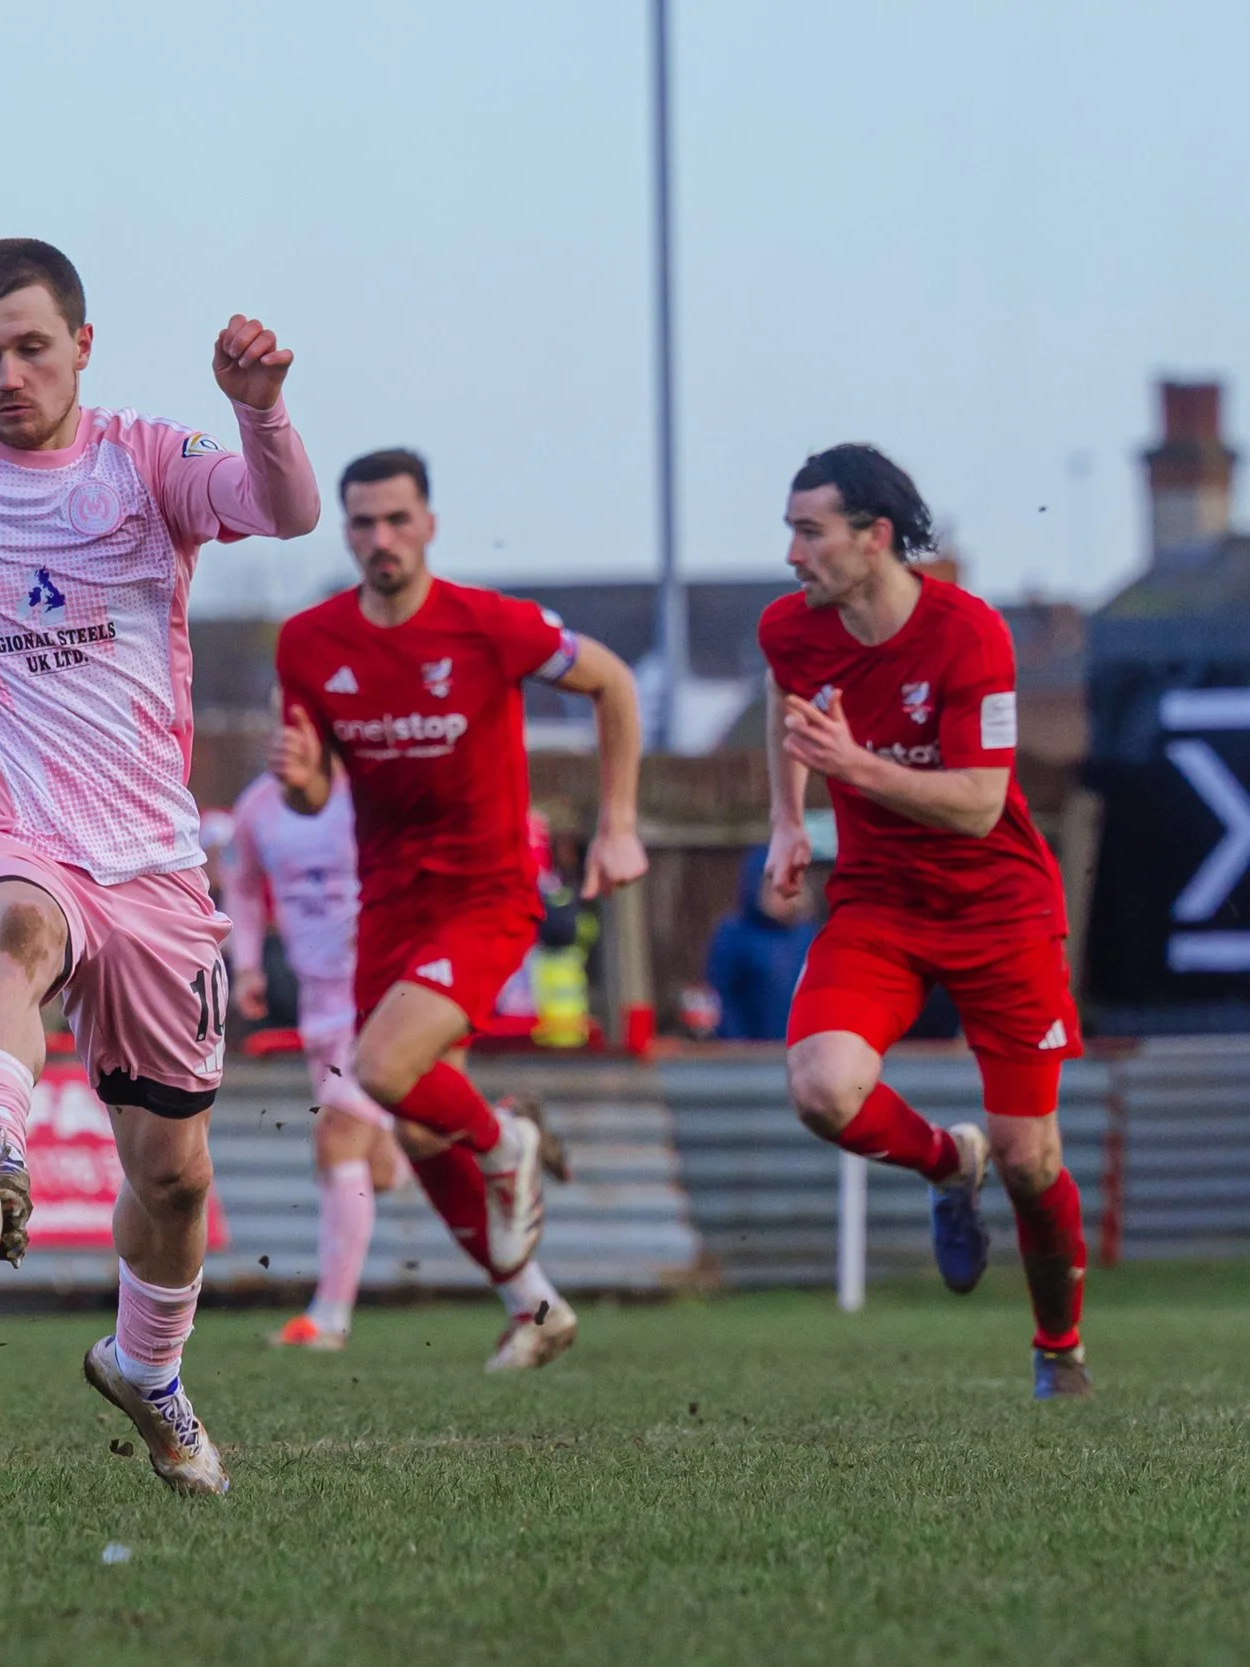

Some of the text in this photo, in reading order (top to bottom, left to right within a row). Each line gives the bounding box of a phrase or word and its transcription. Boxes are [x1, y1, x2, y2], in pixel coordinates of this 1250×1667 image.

[57, 622, 117, 646] STEELS
[26, 649, 89, 673] UK LTD.
[190, 958, 229, 1042] 10
